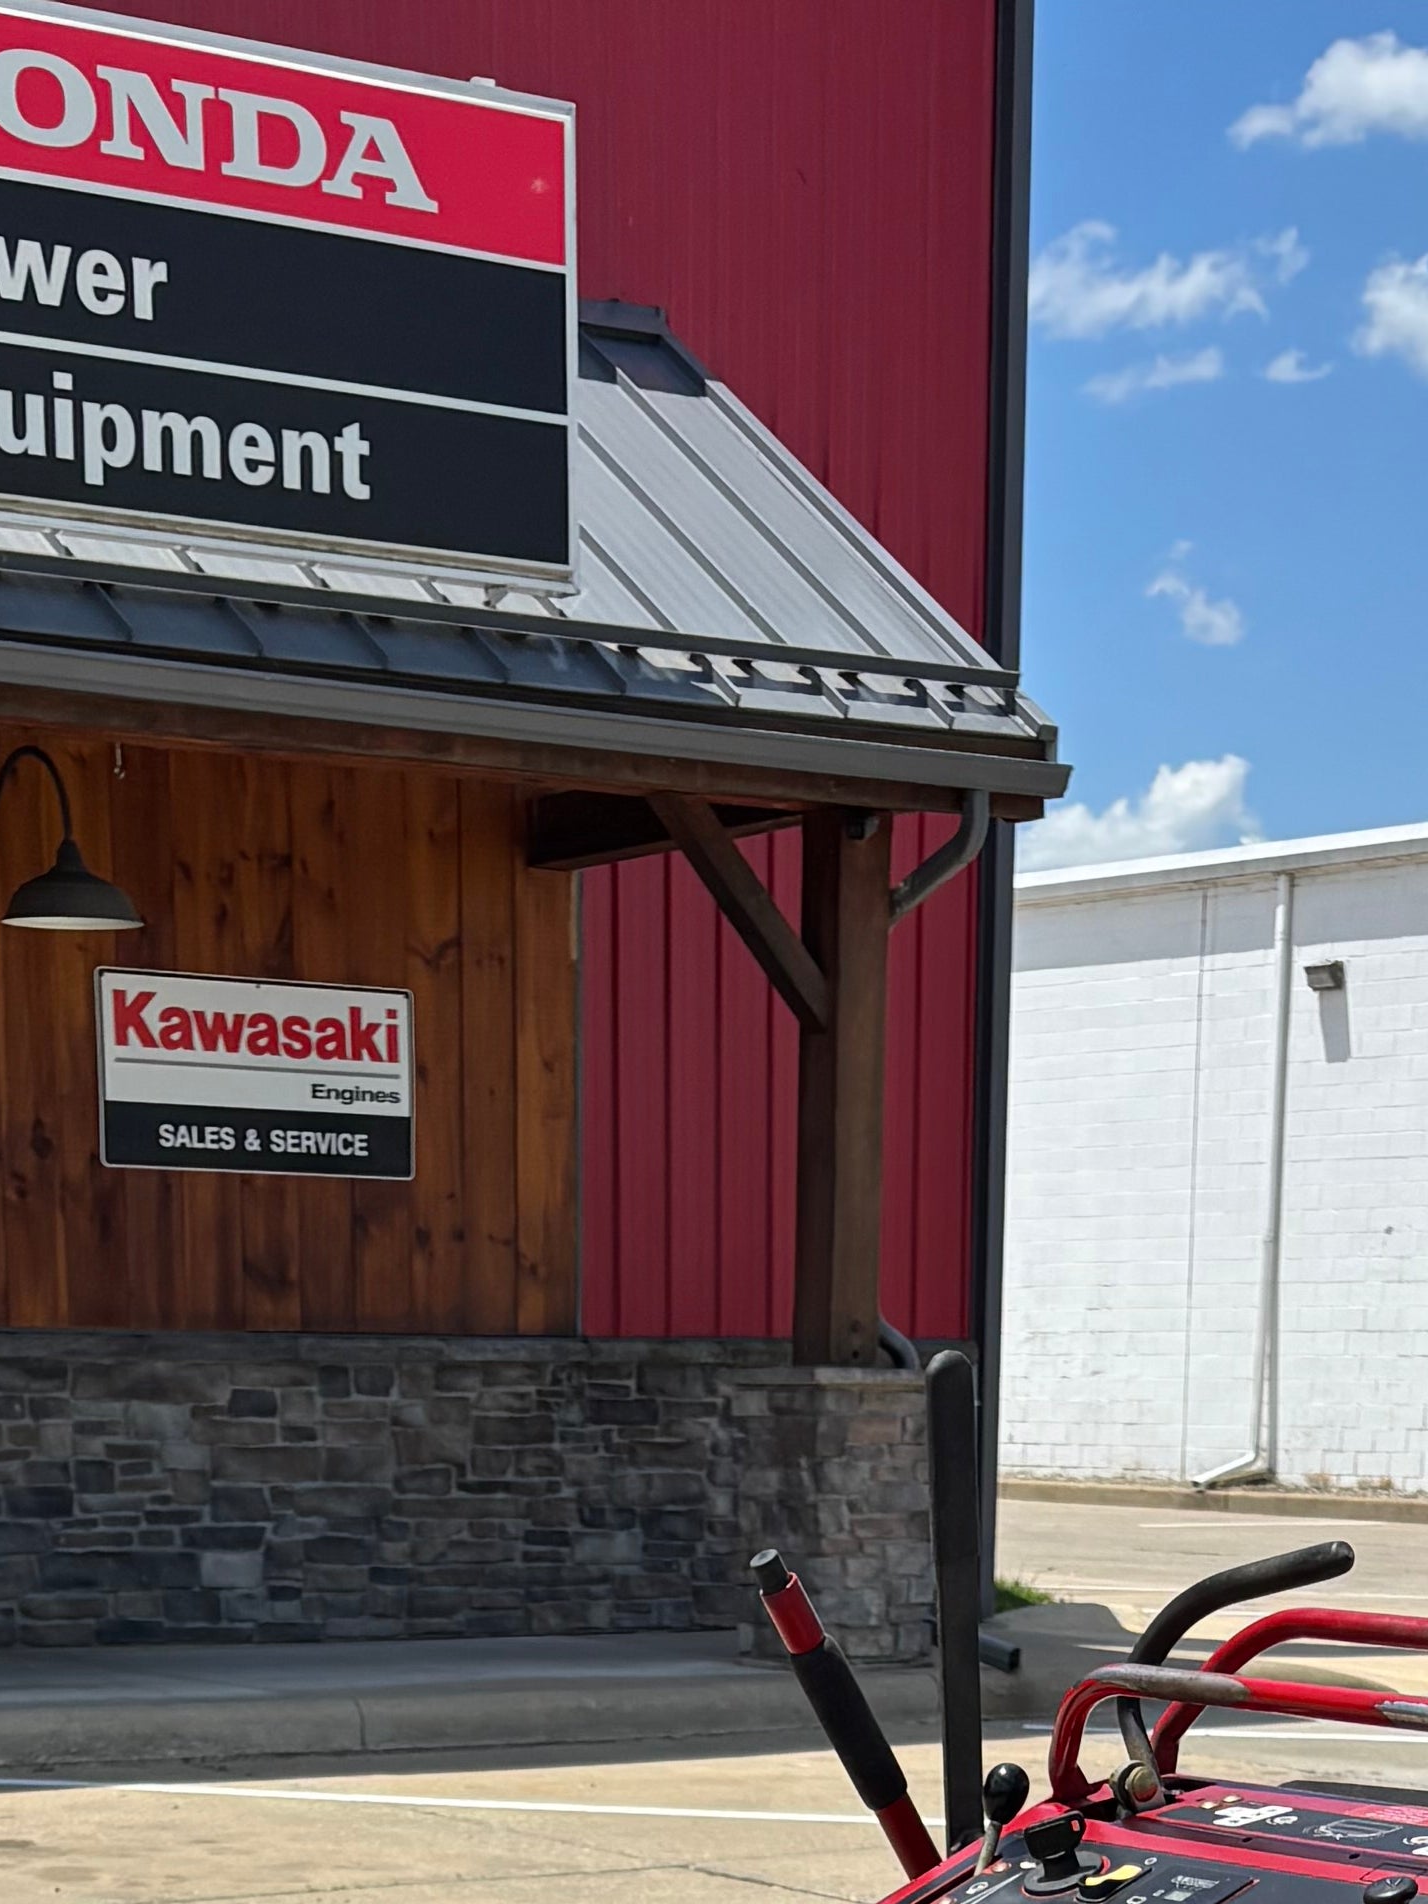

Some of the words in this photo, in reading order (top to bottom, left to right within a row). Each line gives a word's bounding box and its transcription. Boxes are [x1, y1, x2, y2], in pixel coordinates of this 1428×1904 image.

[112, 988, 400, 1064] Kawasaki
[310, 1083, 401, 1105] Engines
[158, 1123, 236, 1151] SALES
[244, 1129, 262, 1152] &
[270, 1129, 369, 1157] SERVICE
